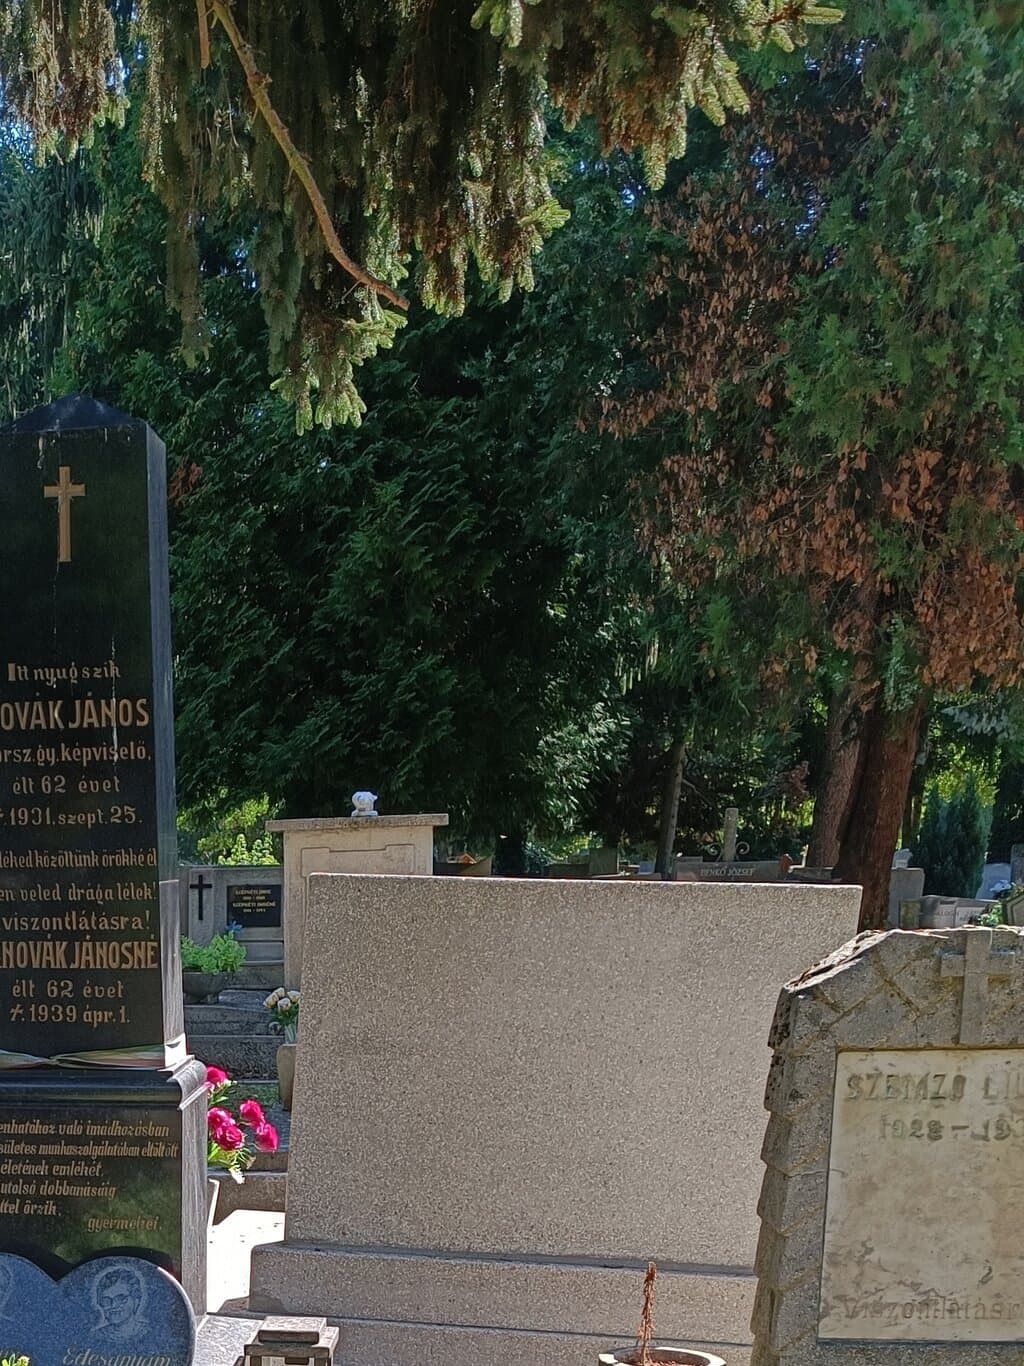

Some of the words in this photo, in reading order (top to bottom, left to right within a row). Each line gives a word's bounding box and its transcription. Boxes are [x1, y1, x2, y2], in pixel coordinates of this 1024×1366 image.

[33, 660, 121, 686] nyugszik
[68, 691, 150, 729] JÁNOS
[12, 776, 34, 795] élt
[41, 775, 66, 794] 62
[78, 776, 121, 795] évet
[20, 883, 61, 902] veled
[68, 882, 114, 905] drága
[2, 910, 151, 931] viszontlátásra!
[1, 933, 68, 969] NOVÁK
[70, 934, 158, 969] JÁNOSNÉ
[12, 980, 34, 998] élt
[47, 980, 74, 998] 62
[83, 979, 123, 998] évet
[31, 1004, 76, 1023] 1939
[83, 1006, 116, 1028] ápr.
